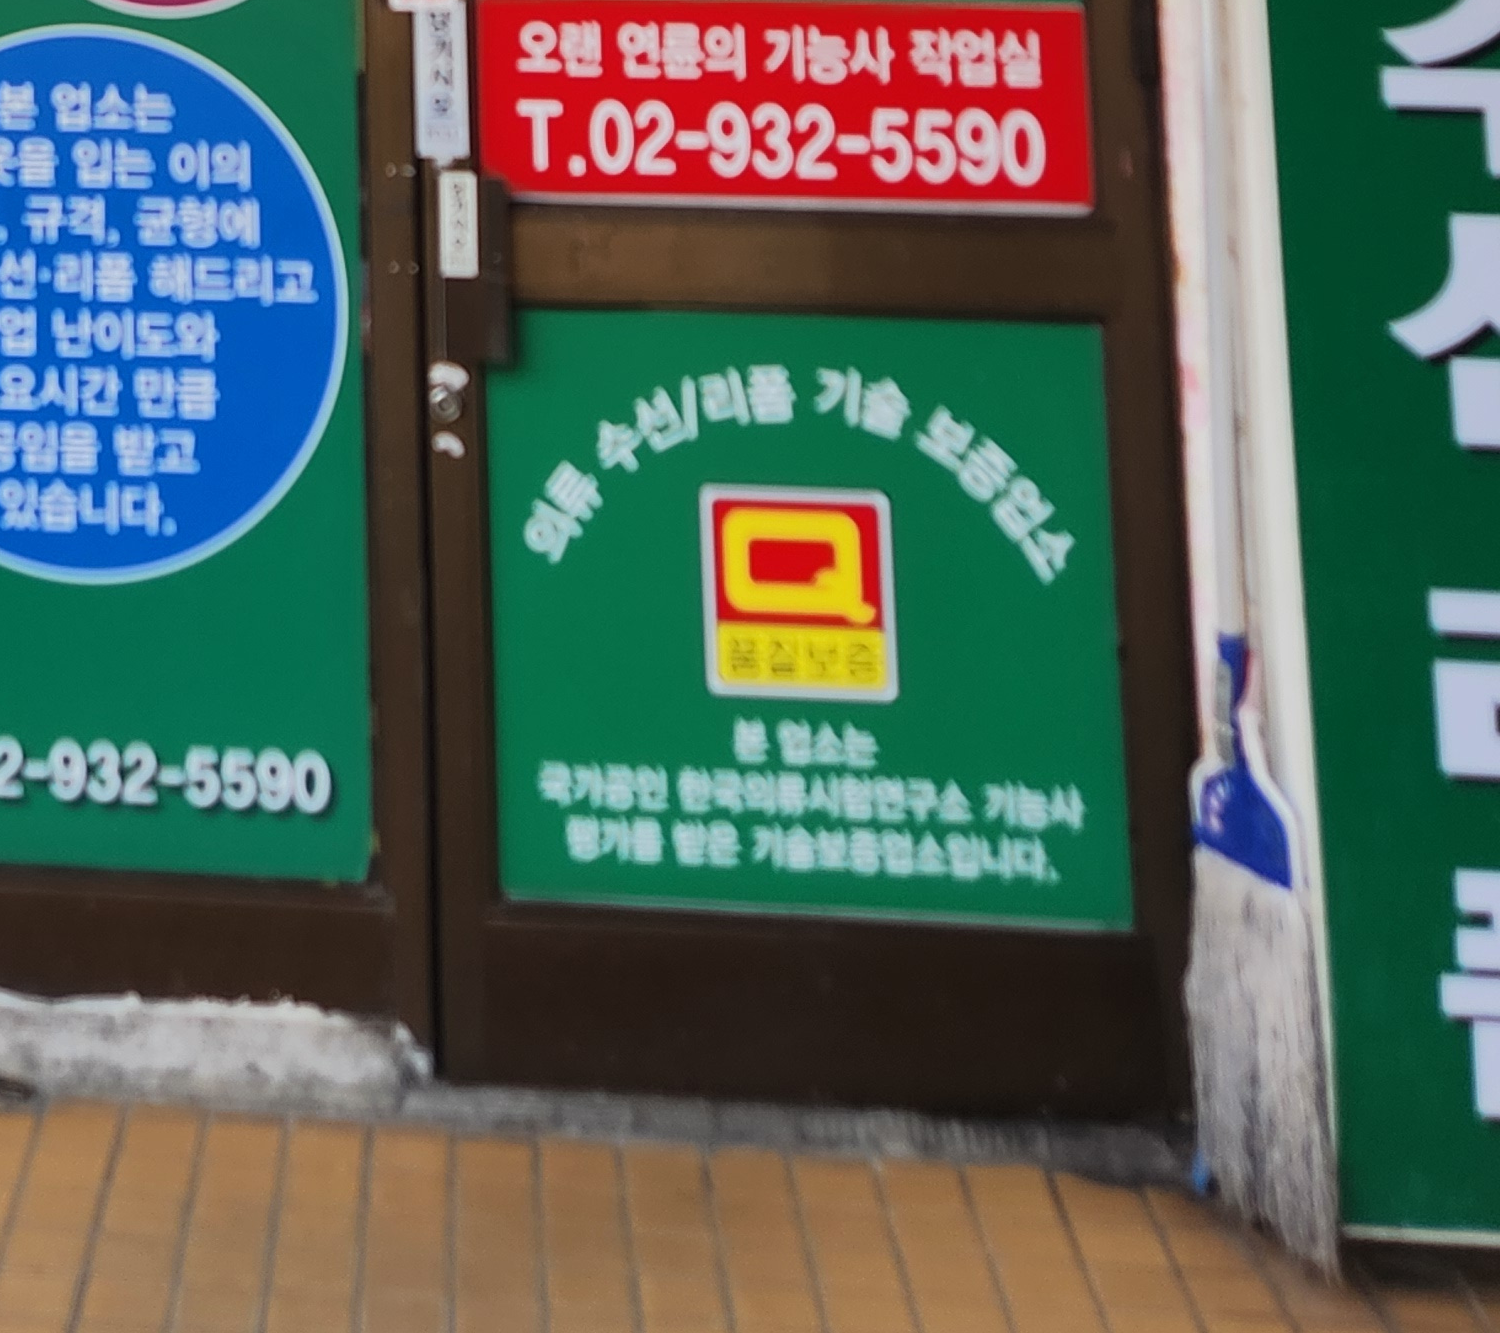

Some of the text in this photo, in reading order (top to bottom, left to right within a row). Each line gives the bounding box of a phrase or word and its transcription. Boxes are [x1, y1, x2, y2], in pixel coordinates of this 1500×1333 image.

[515, 20, 1044, 89] 오랜 연륜의 기능사 작업실
[49, 81, 176, 134] 업소는
[70, 136, 156, 190] 입는
[515, 97, 1047, 188] T.02-932-5590
[133, 195, 262, 250] 균형에
[50, 307, 221, 364] 난이도와
[132, 365, 221, 422] 만큼
[813, 365, 912, 442] 기술
[111, 422, 202, 478] 받고
